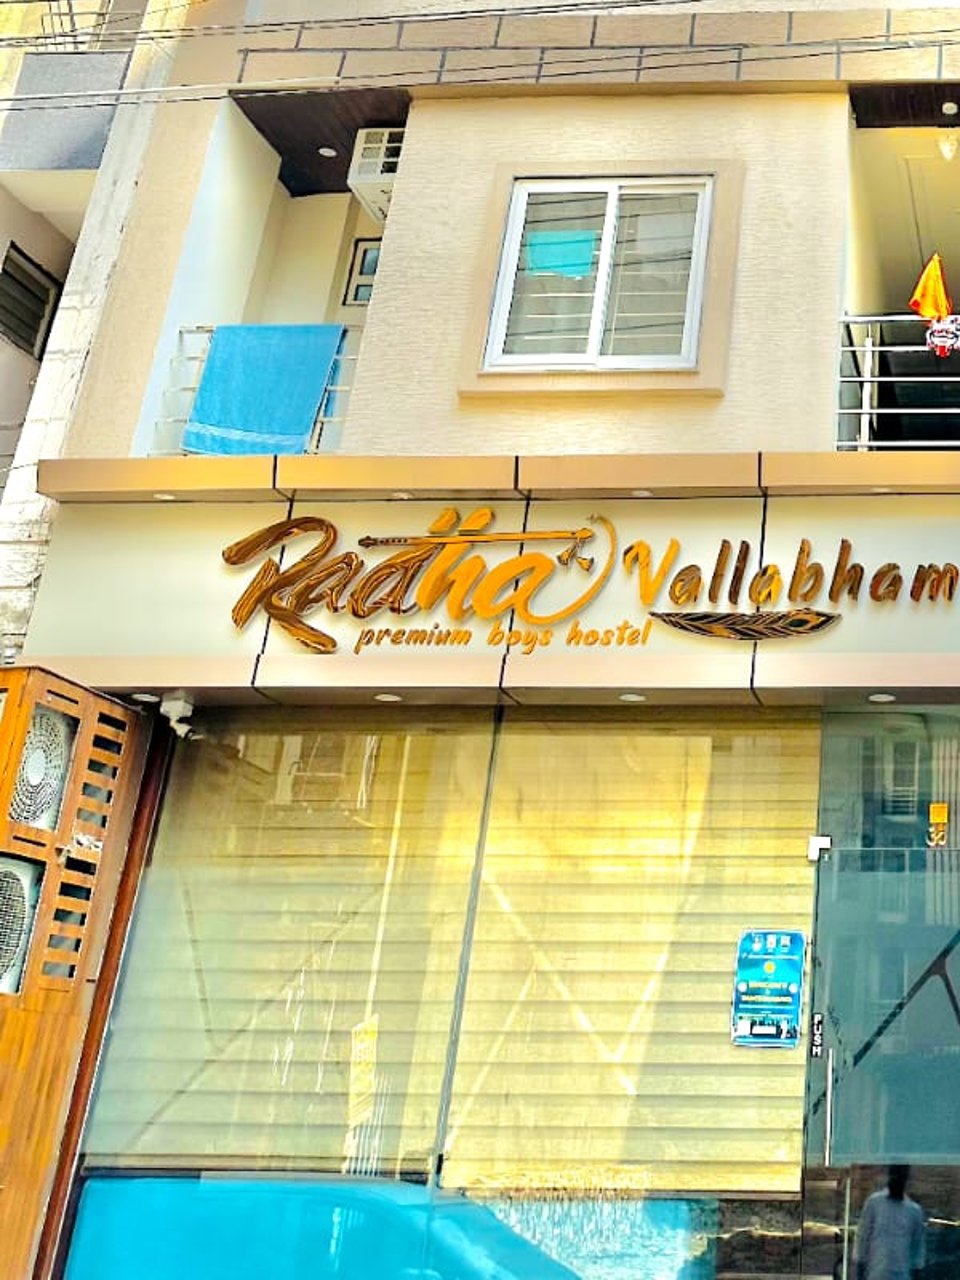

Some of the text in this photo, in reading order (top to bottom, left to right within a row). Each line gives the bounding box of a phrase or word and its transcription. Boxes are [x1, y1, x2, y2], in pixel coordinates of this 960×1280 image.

[223, 508, 960, 653] Radha Vallabham
[353, 620, 653, 654] premium boys hostel
[812, 1013, 823, 1057] PUSH
